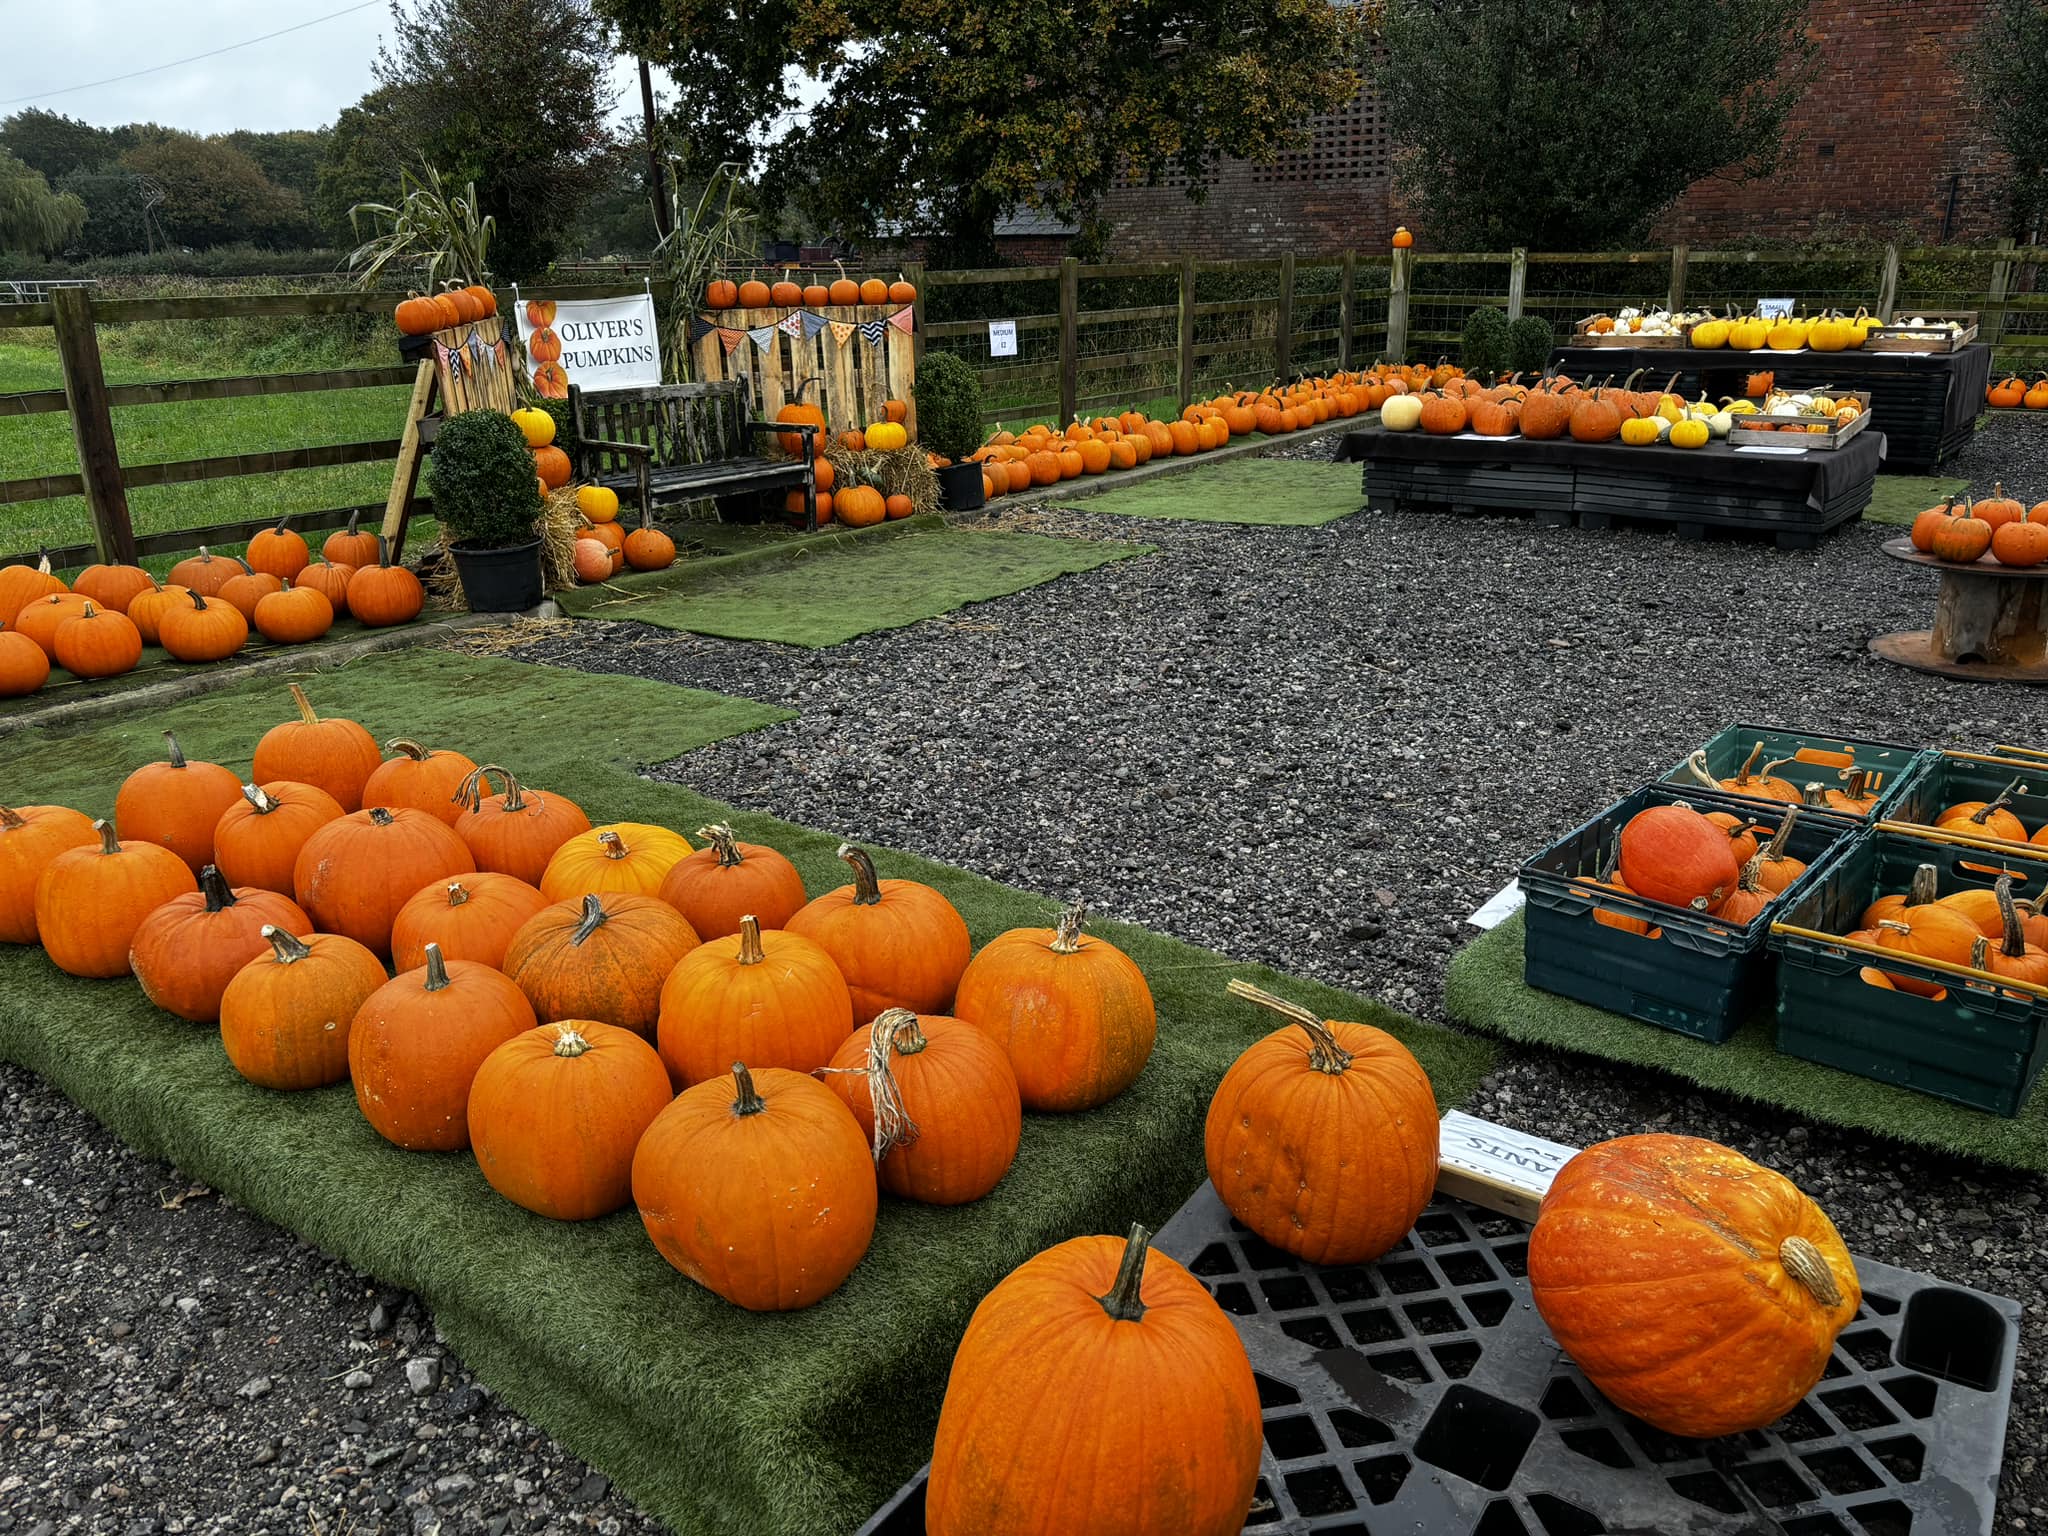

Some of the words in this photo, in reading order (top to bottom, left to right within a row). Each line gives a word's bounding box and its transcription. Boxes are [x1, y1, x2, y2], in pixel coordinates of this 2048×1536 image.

[561, 318, 644, 342] OLIVER'S
[993, 329, 1014, 337] MEDIUM
[563, 345, 654, 369] PUMPKINS
[1467, 1138, 1557, 1173] ANTS
